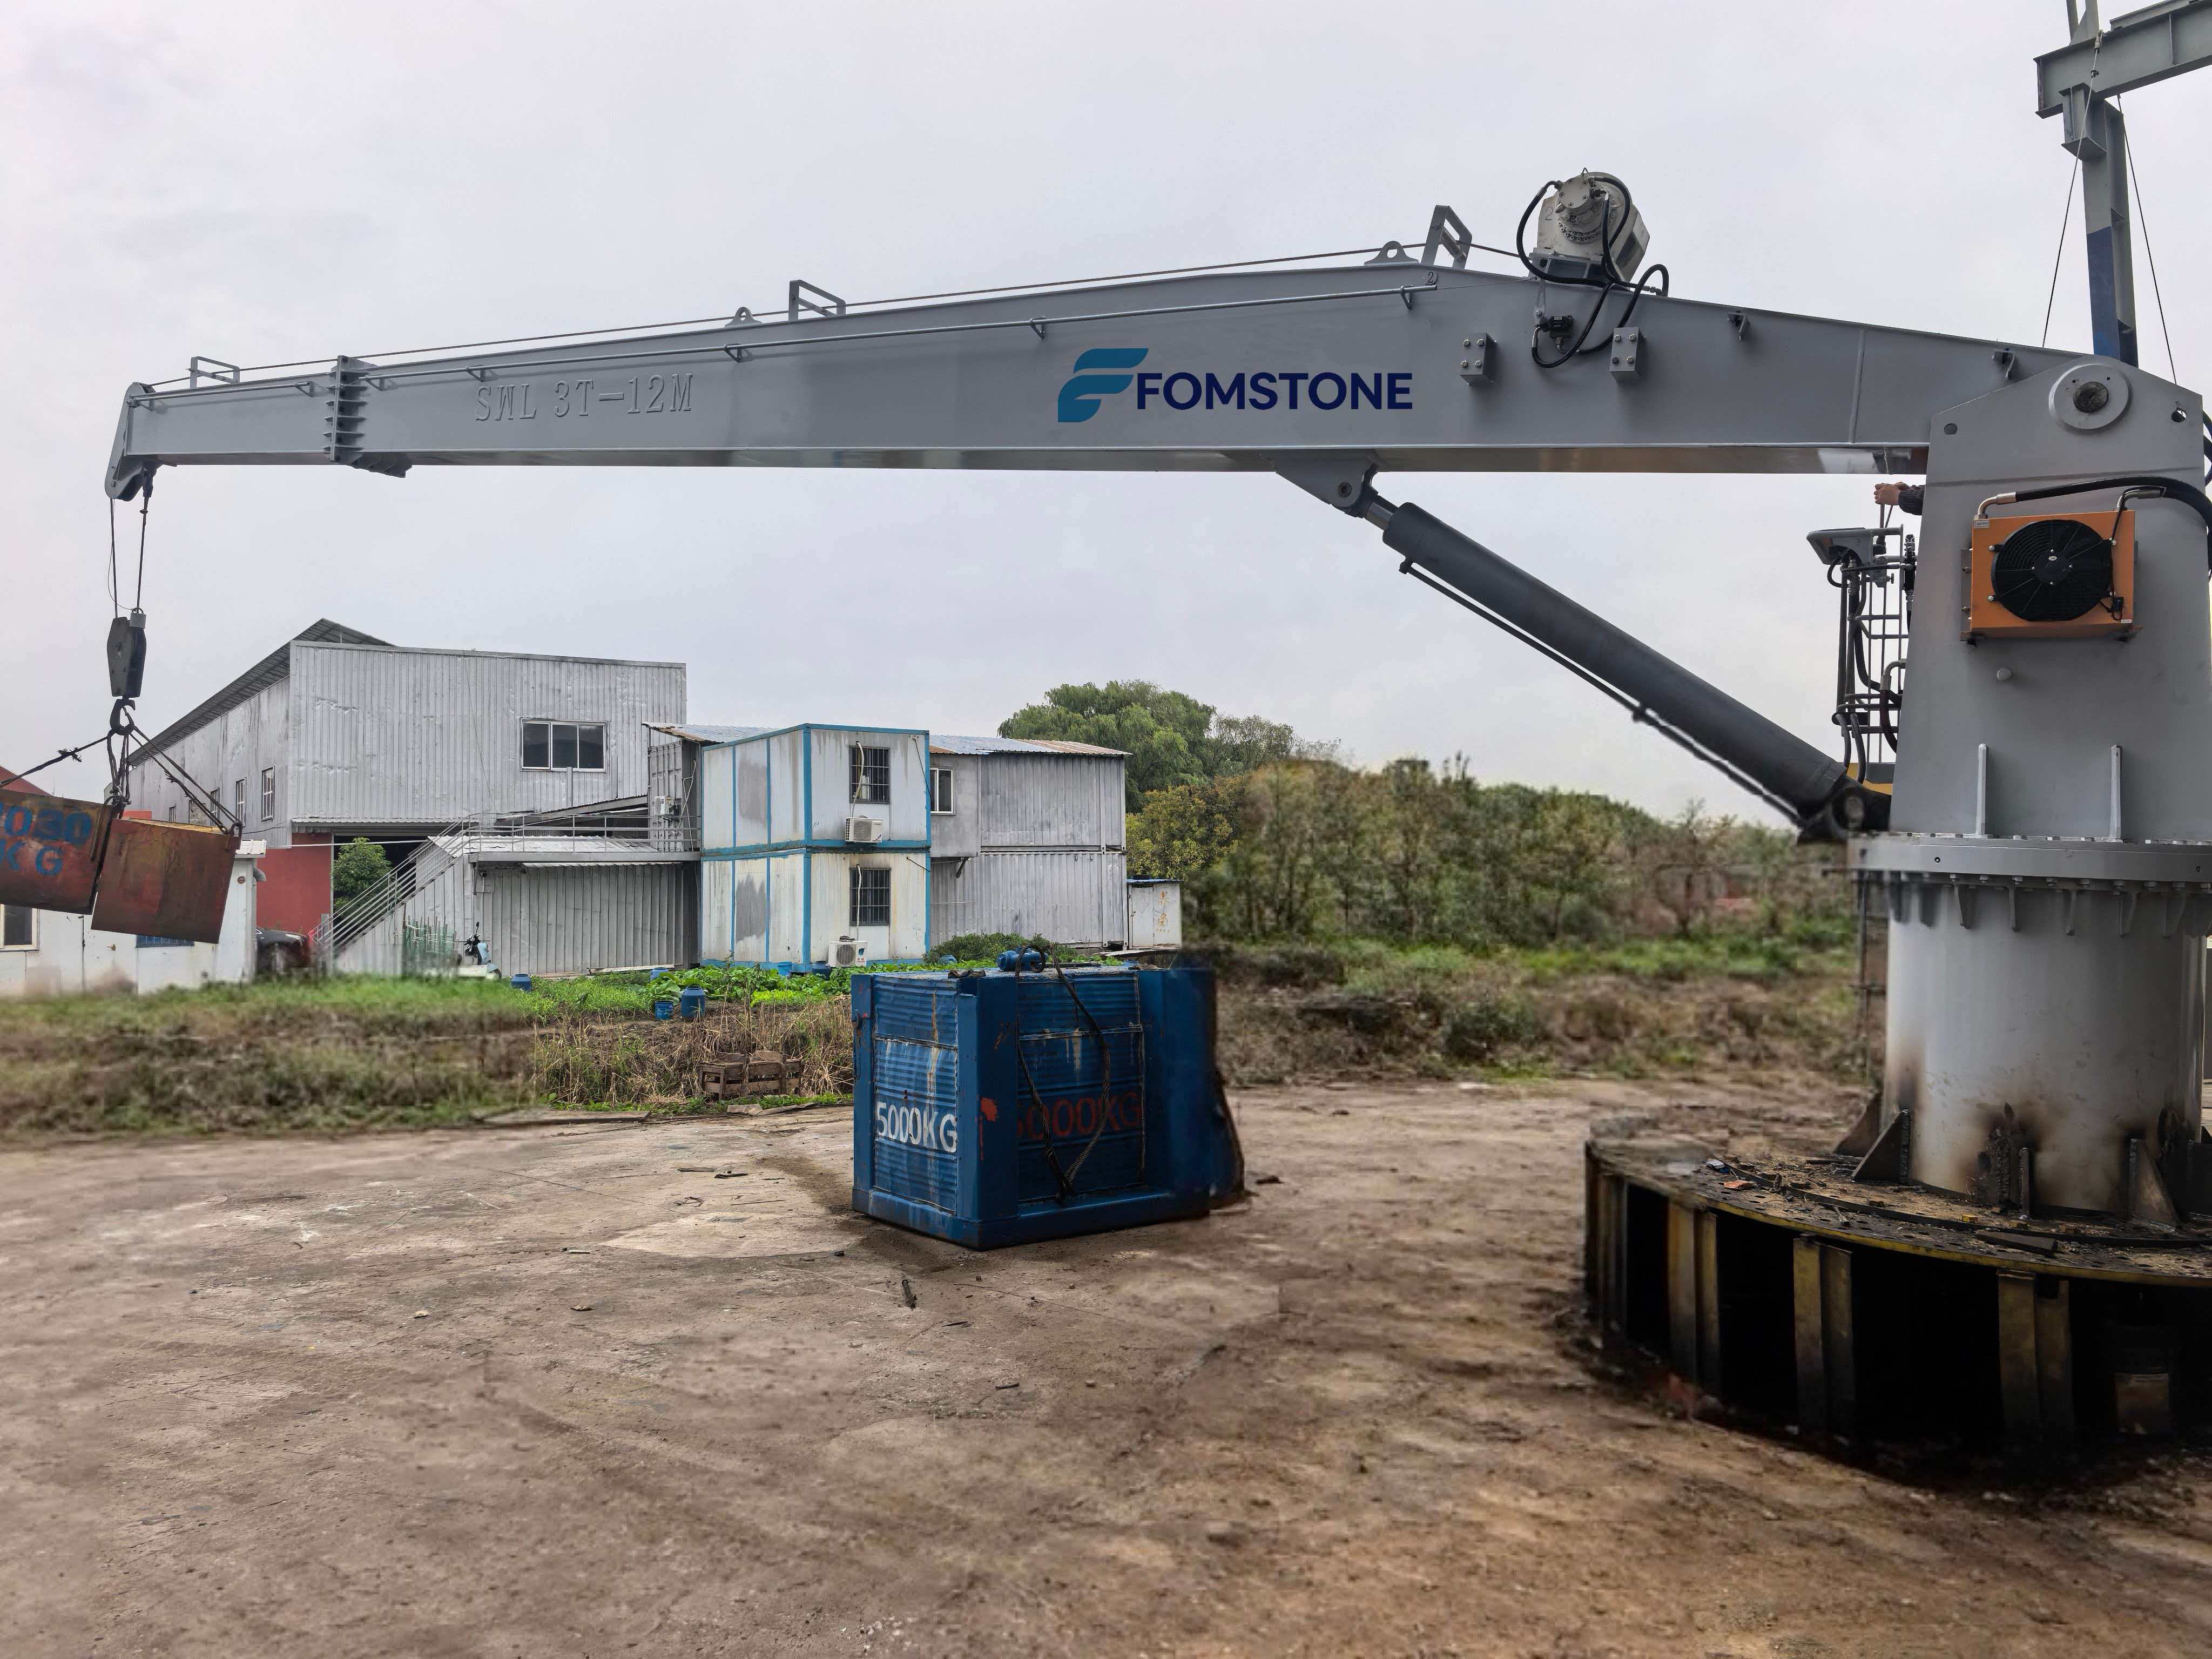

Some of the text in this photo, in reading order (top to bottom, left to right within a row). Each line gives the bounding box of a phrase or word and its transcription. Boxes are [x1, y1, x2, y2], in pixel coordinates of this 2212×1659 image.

[476, 384, 536, 421] SWL
[1137, 372, 1413, 409] FOMSTONE
[876, 1101, 957, 1153] 5000KG
